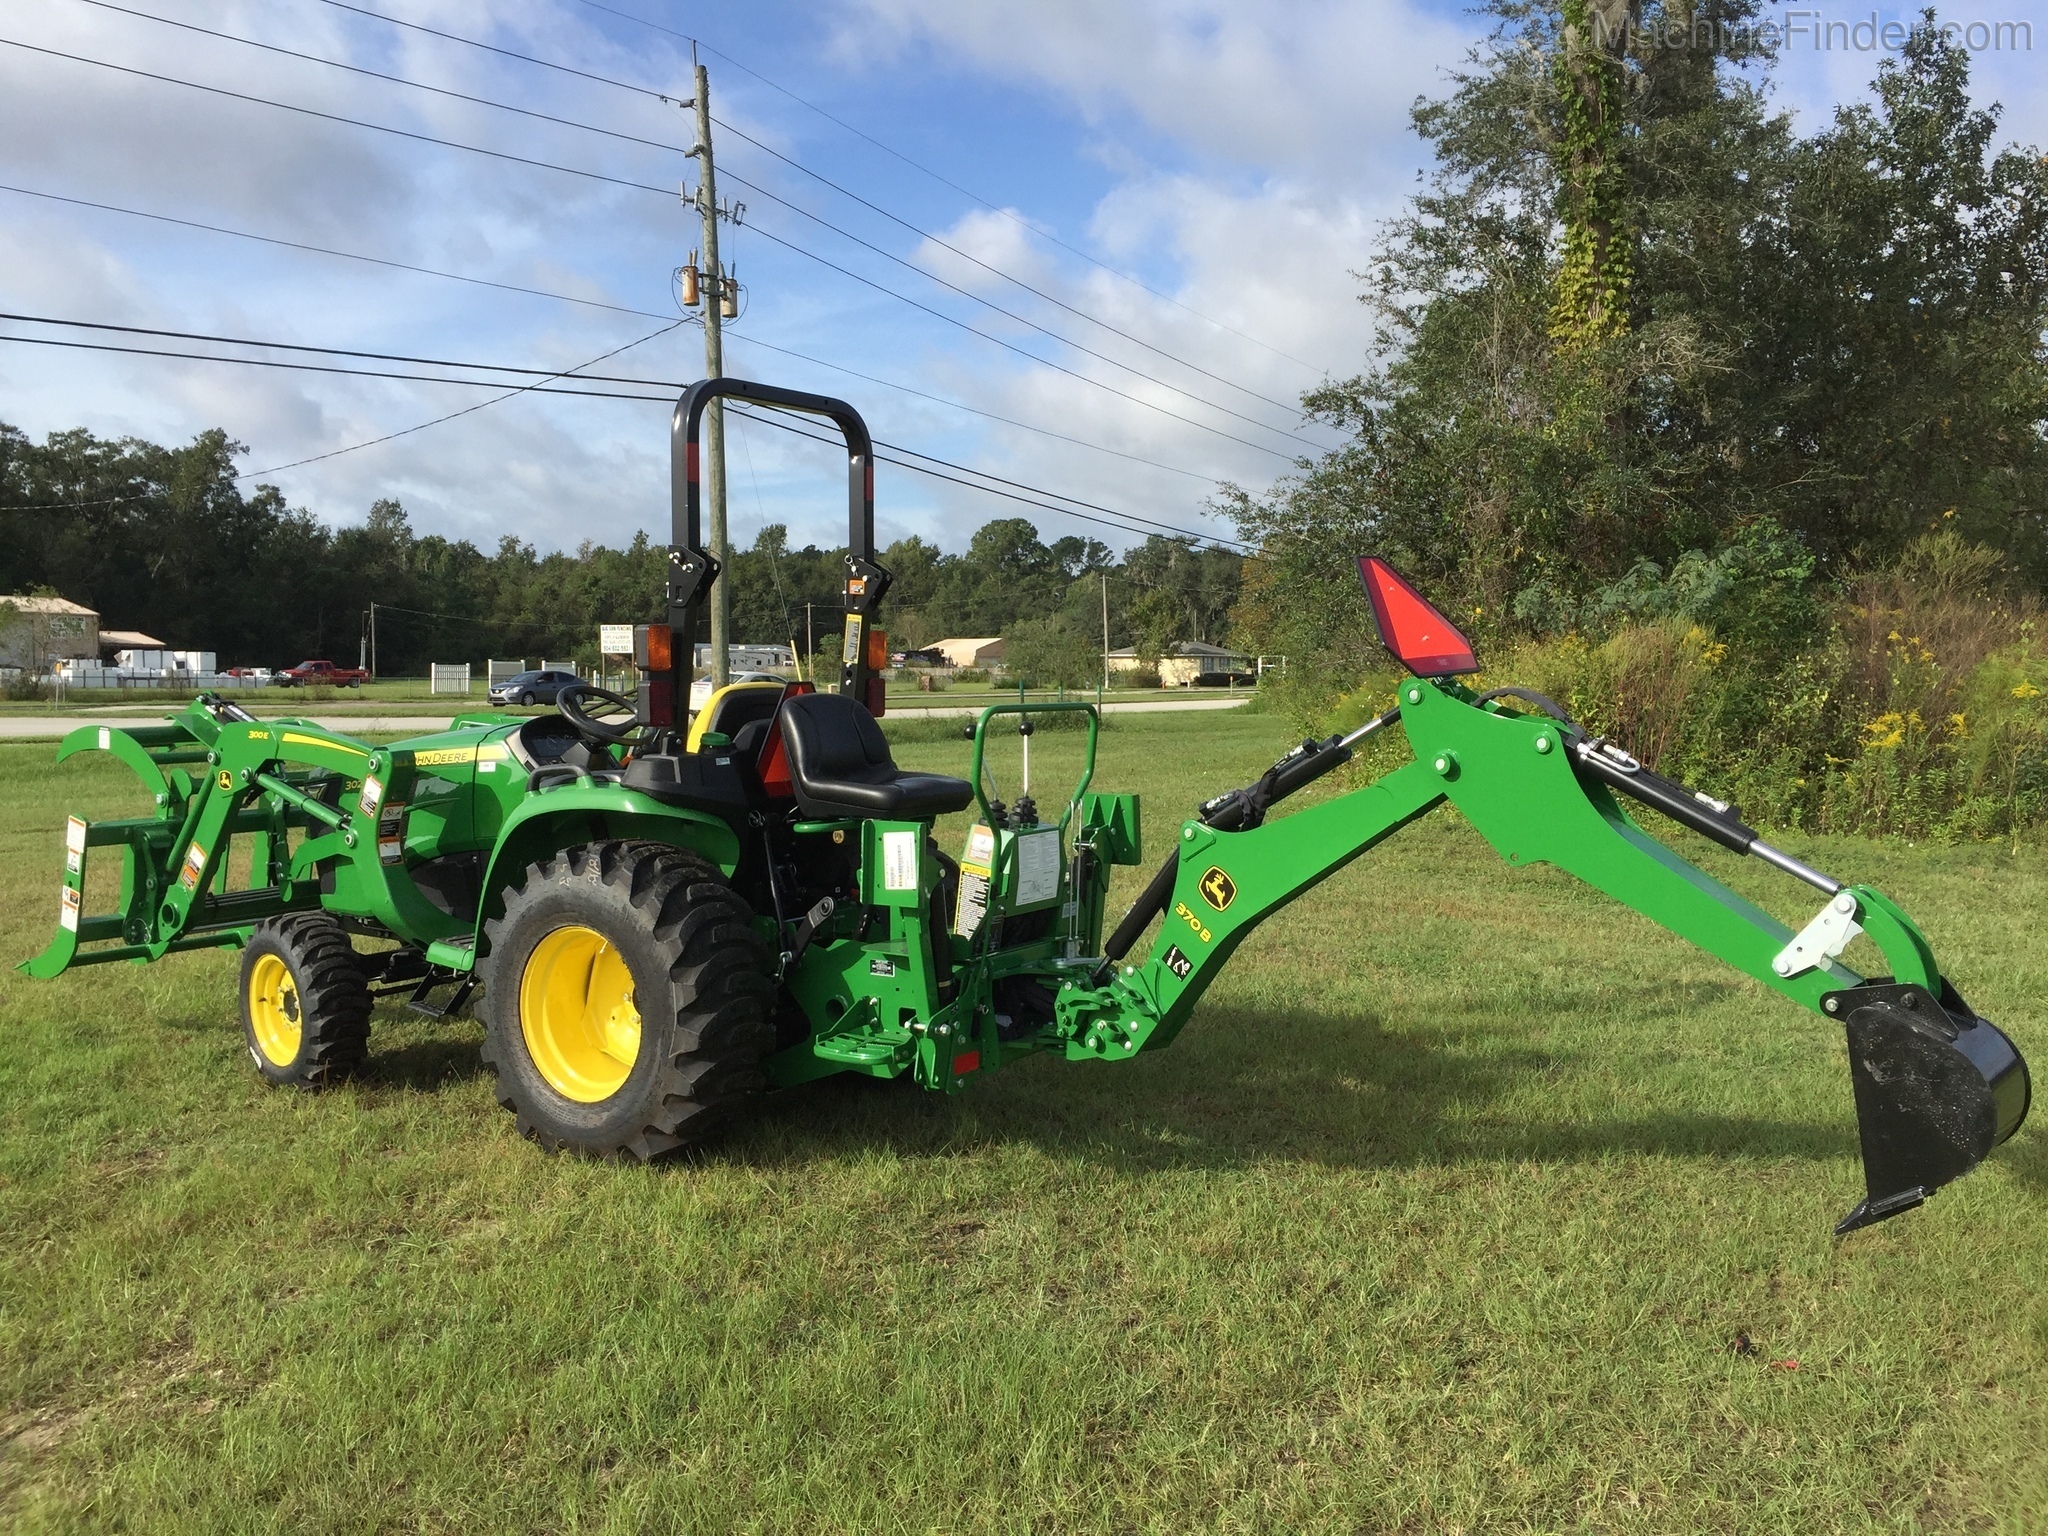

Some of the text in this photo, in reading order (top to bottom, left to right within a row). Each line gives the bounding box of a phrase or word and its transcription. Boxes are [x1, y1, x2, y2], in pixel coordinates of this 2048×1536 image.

[248, 730, 269, 740] 300E
[432, 752, 468, 764] DEERE
[344, 780, 362, 791] 302
[1174, 901, 1213, 943] 370B
